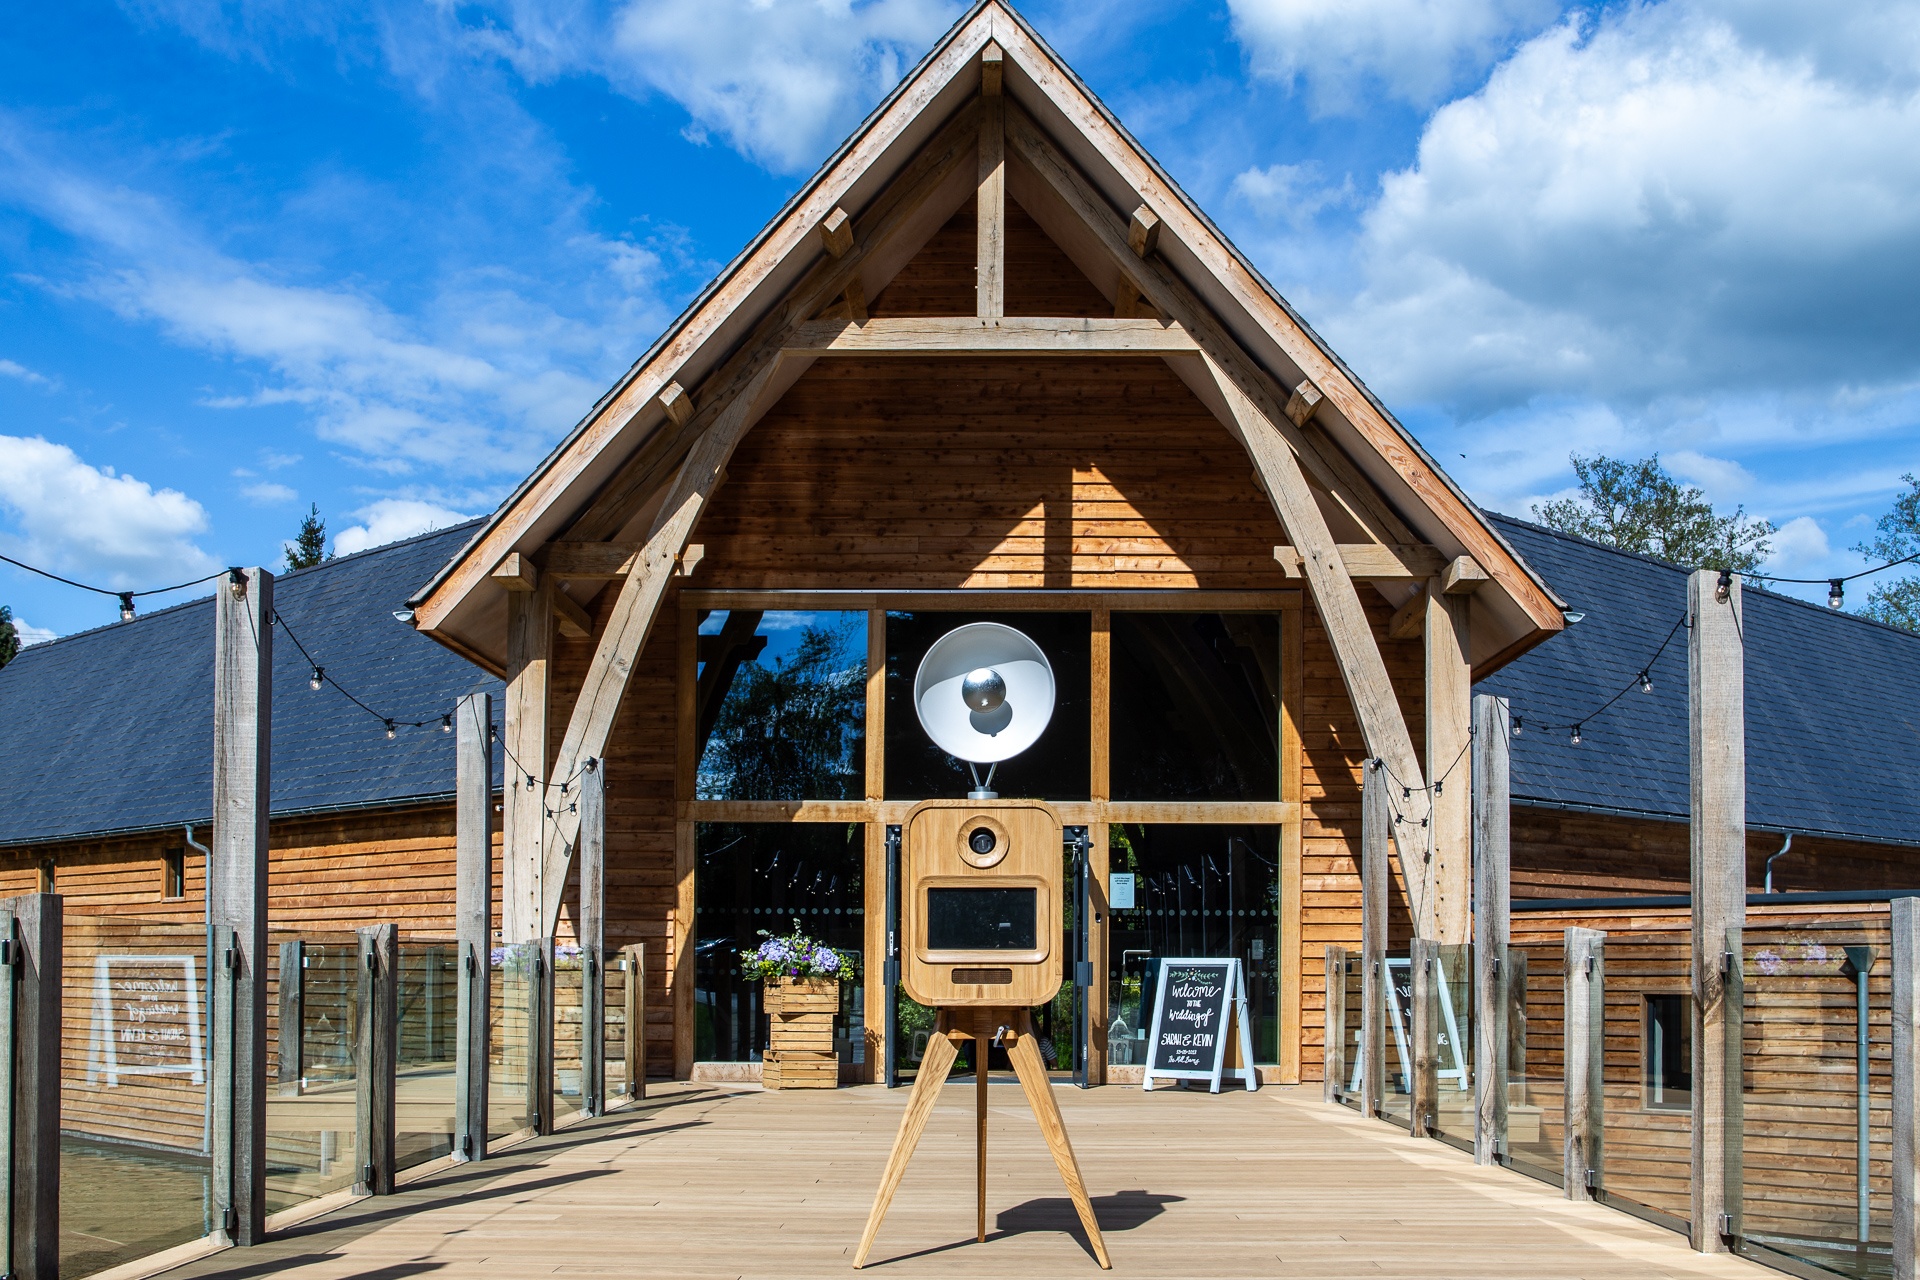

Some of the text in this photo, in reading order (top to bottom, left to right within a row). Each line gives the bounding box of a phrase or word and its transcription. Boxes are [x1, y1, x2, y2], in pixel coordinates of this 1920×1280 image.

[1192, 1000, 1202, 1008] THE
[1161, 1033, 1213, 1047] SARAH & KEVIN
